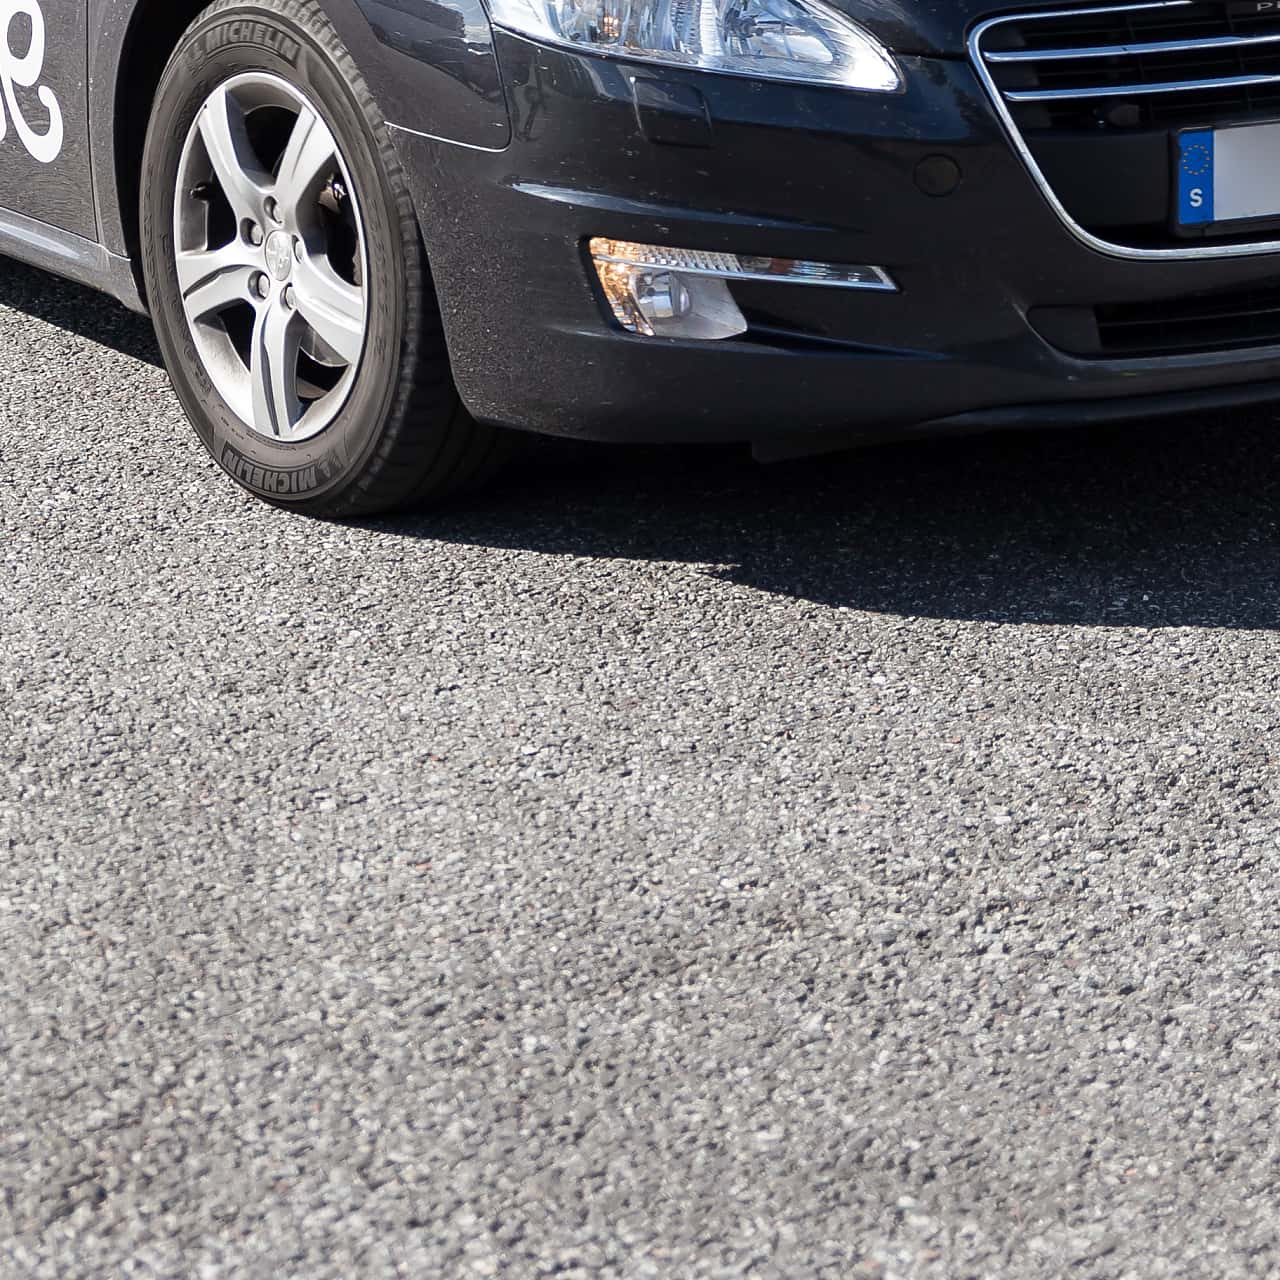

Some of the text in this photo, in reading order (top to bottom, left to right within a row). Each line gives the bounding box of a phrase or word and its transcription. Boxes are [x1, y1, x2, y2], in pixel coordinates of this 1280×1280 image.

[205, 20, 300, 62] MICHELIN
[1189, 188, 1204, 209] S
[221, 445, 318, 495] MICHELIN
